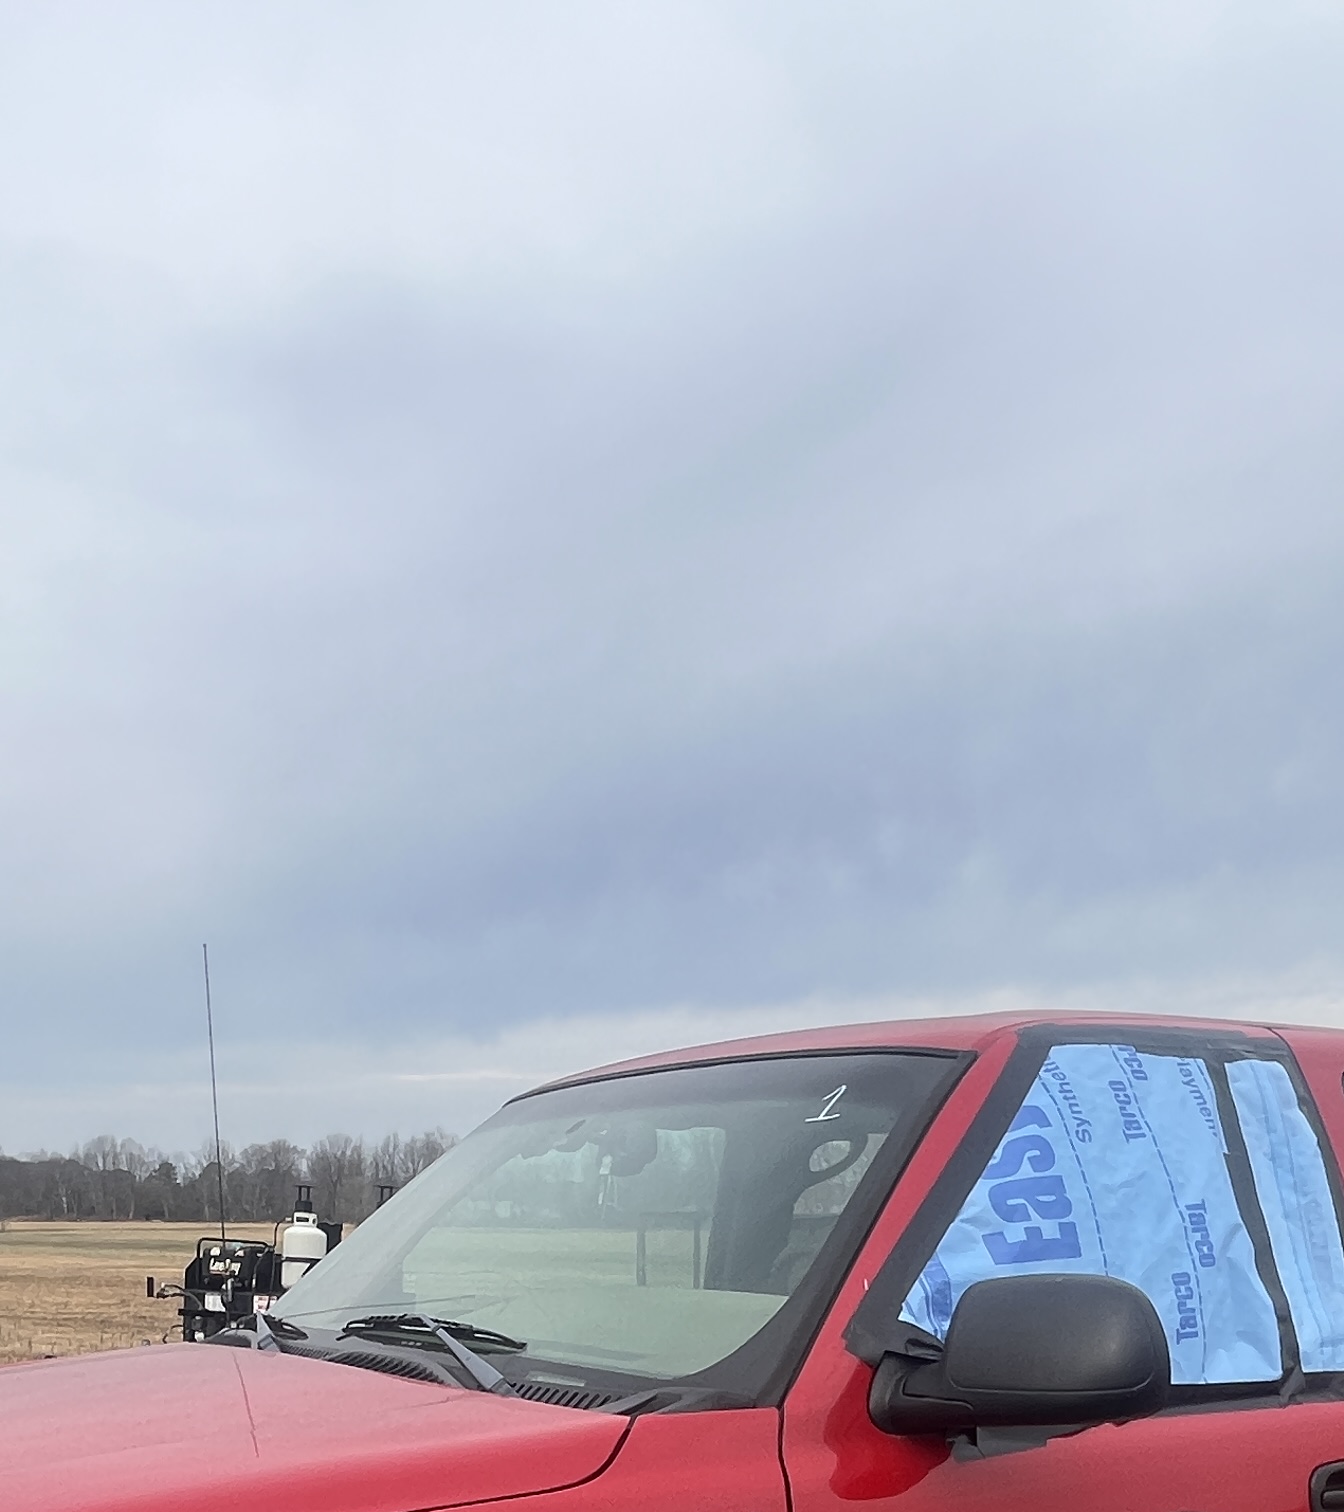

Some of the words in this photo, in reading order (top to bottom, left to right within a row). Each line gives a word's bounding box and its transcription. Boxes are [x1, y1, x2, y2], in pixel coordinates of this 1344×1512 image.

[1117, 1045, 1148, 1081] rco
[804, 1083, 848, 1124] 1
[1108, 1079, 1147, 1145] Tarco
[1184, 1198, 1217, 1268] Tarco
[1171, 1271, 1200, 1346] Tarco
